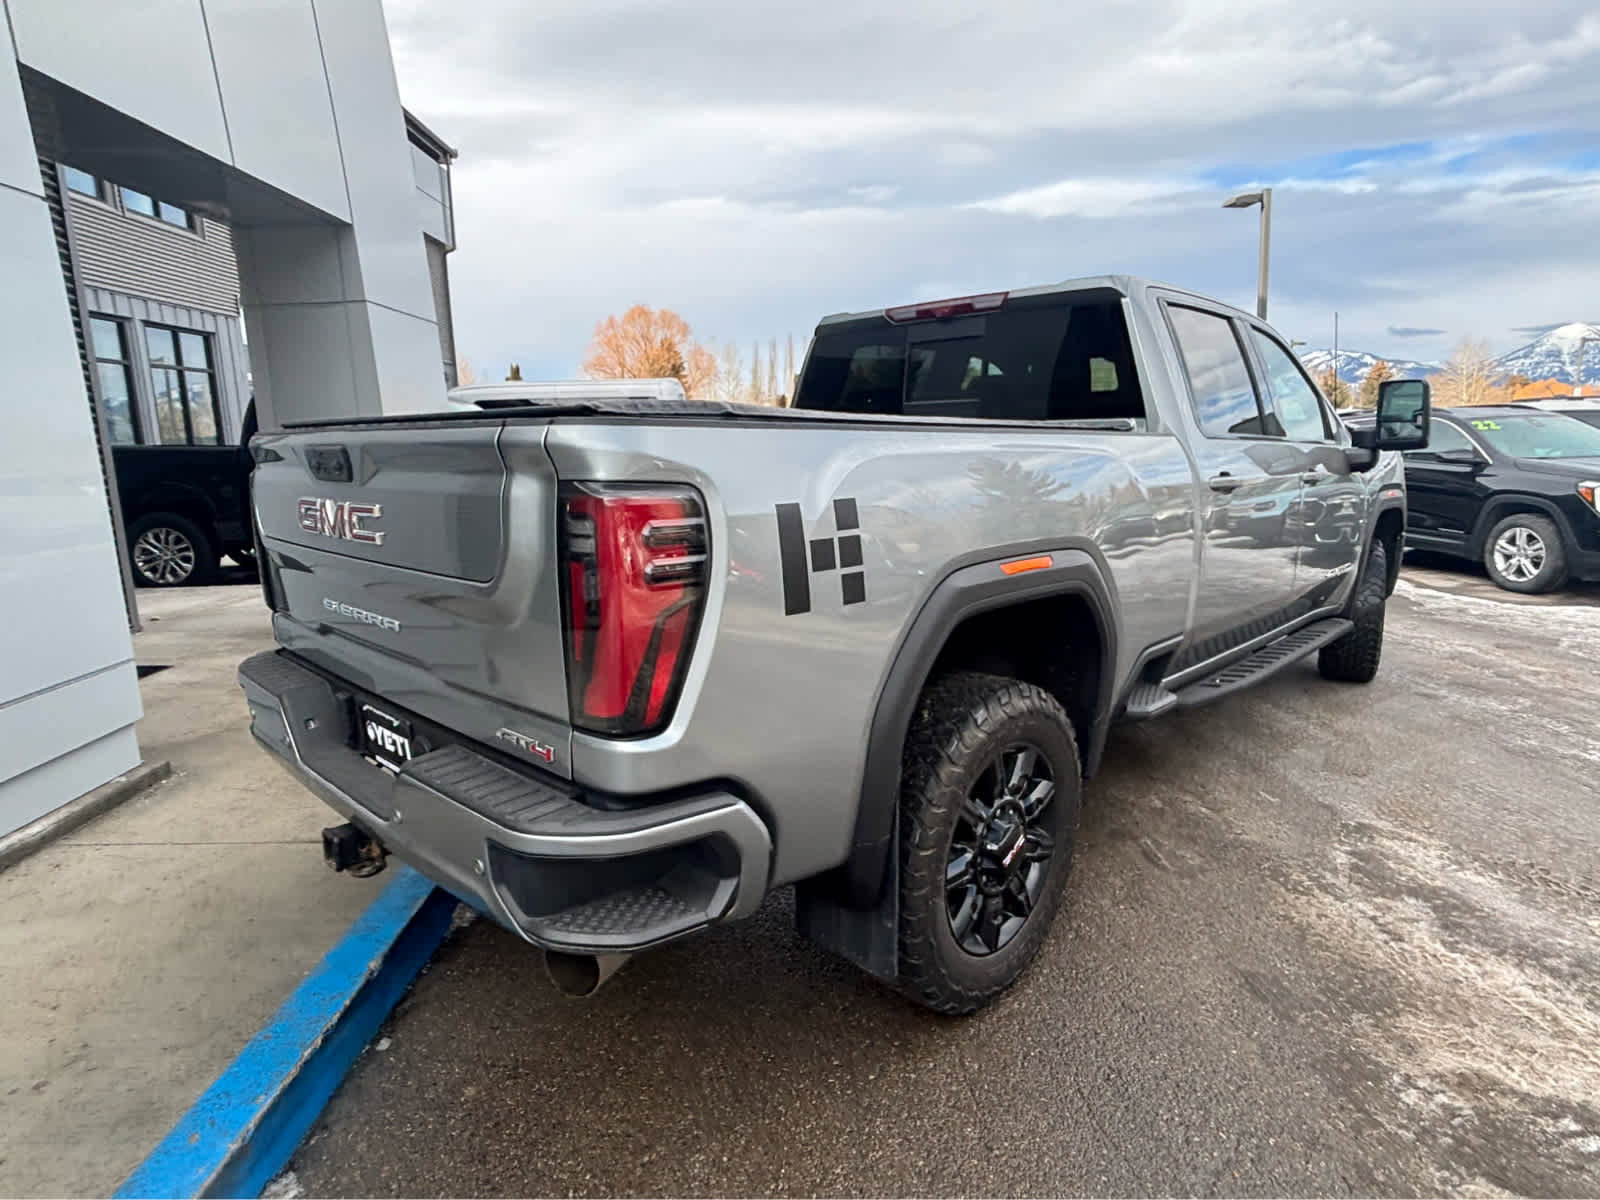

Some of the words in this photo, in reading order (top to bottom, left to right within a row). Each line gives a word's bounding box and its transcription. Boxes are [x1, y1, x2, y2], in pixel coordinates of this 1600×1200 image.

[1471, 420, 1502, 431] 22
[297, 497, 384, 545] GMC
[323, 598, 400, 632] SIERRA
[371, 721, 412, 760] YETI
